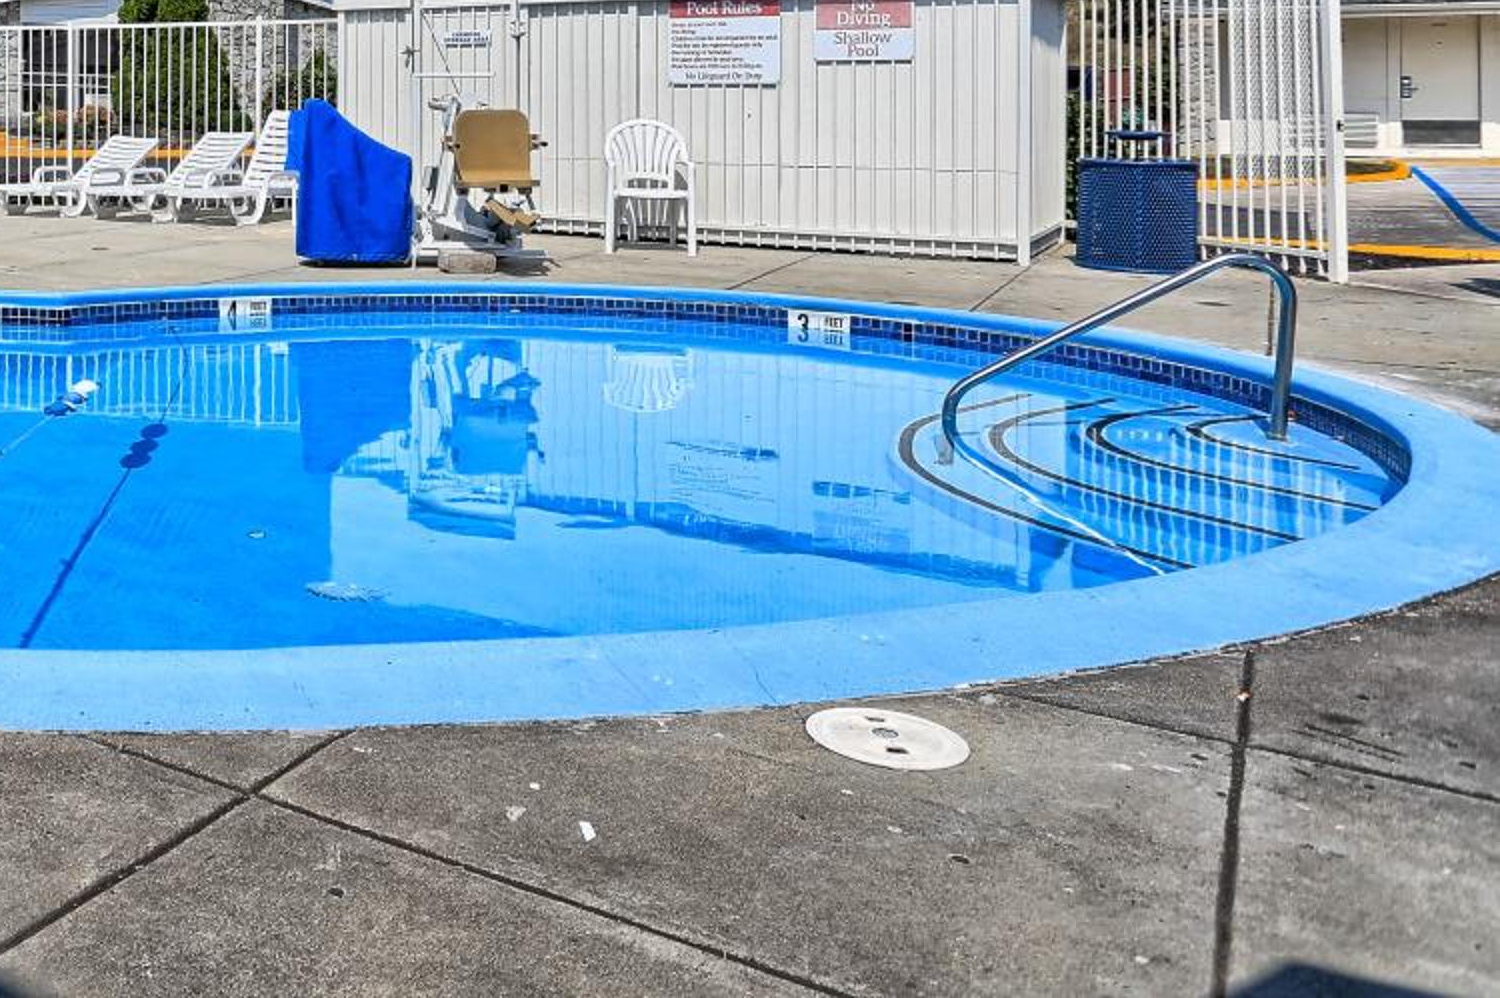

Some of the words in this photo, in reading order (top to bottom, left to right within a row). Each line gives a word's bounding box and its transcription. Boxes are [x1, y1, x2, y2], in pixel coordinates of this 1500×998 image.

[686, 1, 718, 15] Pool
[722, 0, 763, 15] Rules
[837, 11, 891, 27] Diving
[835, 32, 892, 44] Shallow
[848, 44, 879, 57] Pool
